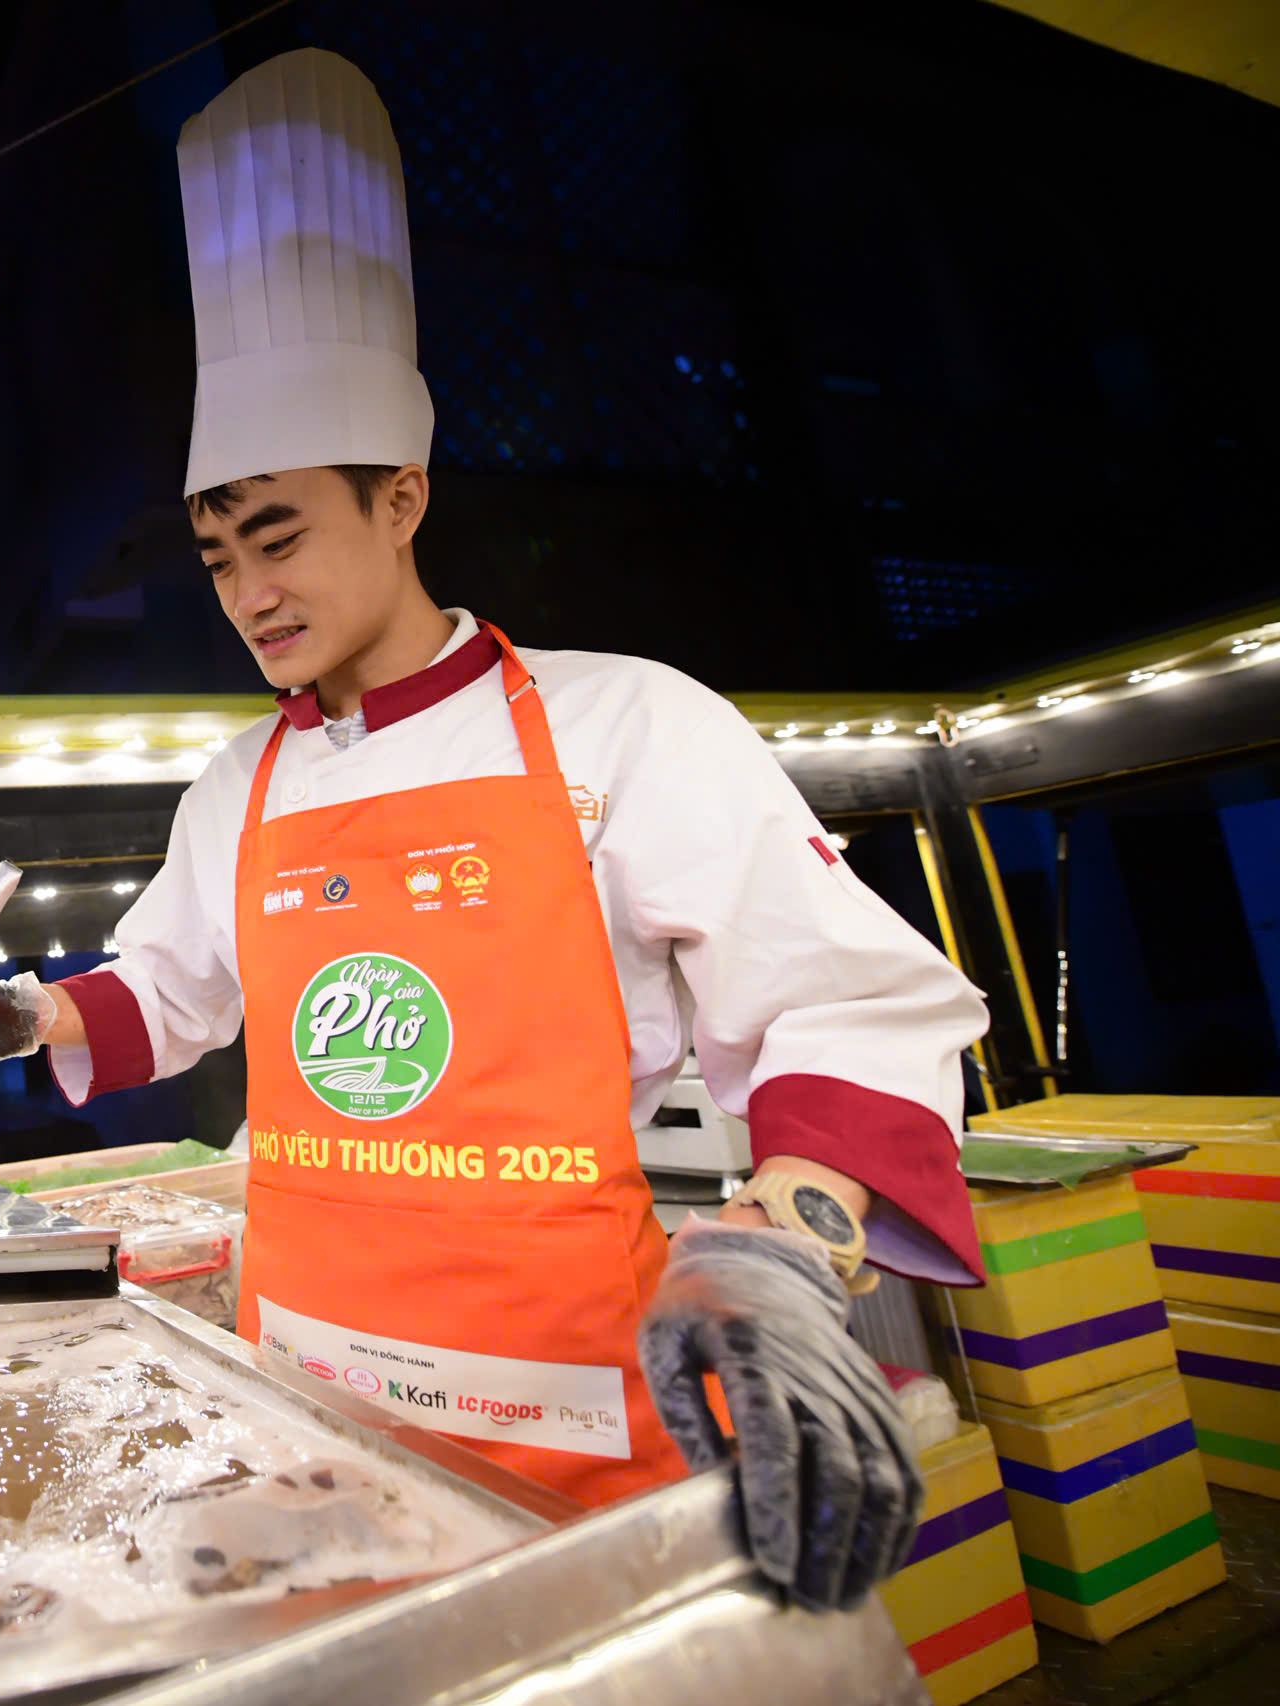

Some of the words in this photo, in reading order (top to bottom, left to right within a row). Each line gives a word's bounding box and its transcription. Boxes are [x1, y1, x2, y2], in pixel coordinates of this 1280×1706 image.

[339, 959, 403, 990] Ngày
[394, 982, 425, 1000] của
[307, 980, 427, 1056] Phở
[349, 1094, 386, 1105] 12/12
[253, 1125, 279, 1162] PHỞ
[283, 1129, 329, 1169] YÊU
[338, 1138, 486, 1180] THƯƠNG
[497, 1145, 600, 1184] 2025
[349, 1343, 368, 1355] ĐƠN
[369, 1348, 379, 1358] VỊ
[407, 1355, 435, 1369] HÀNH
[406, 1384, 447, 1410] Kafi
[480, 1399, 544, 1421] FOODS
